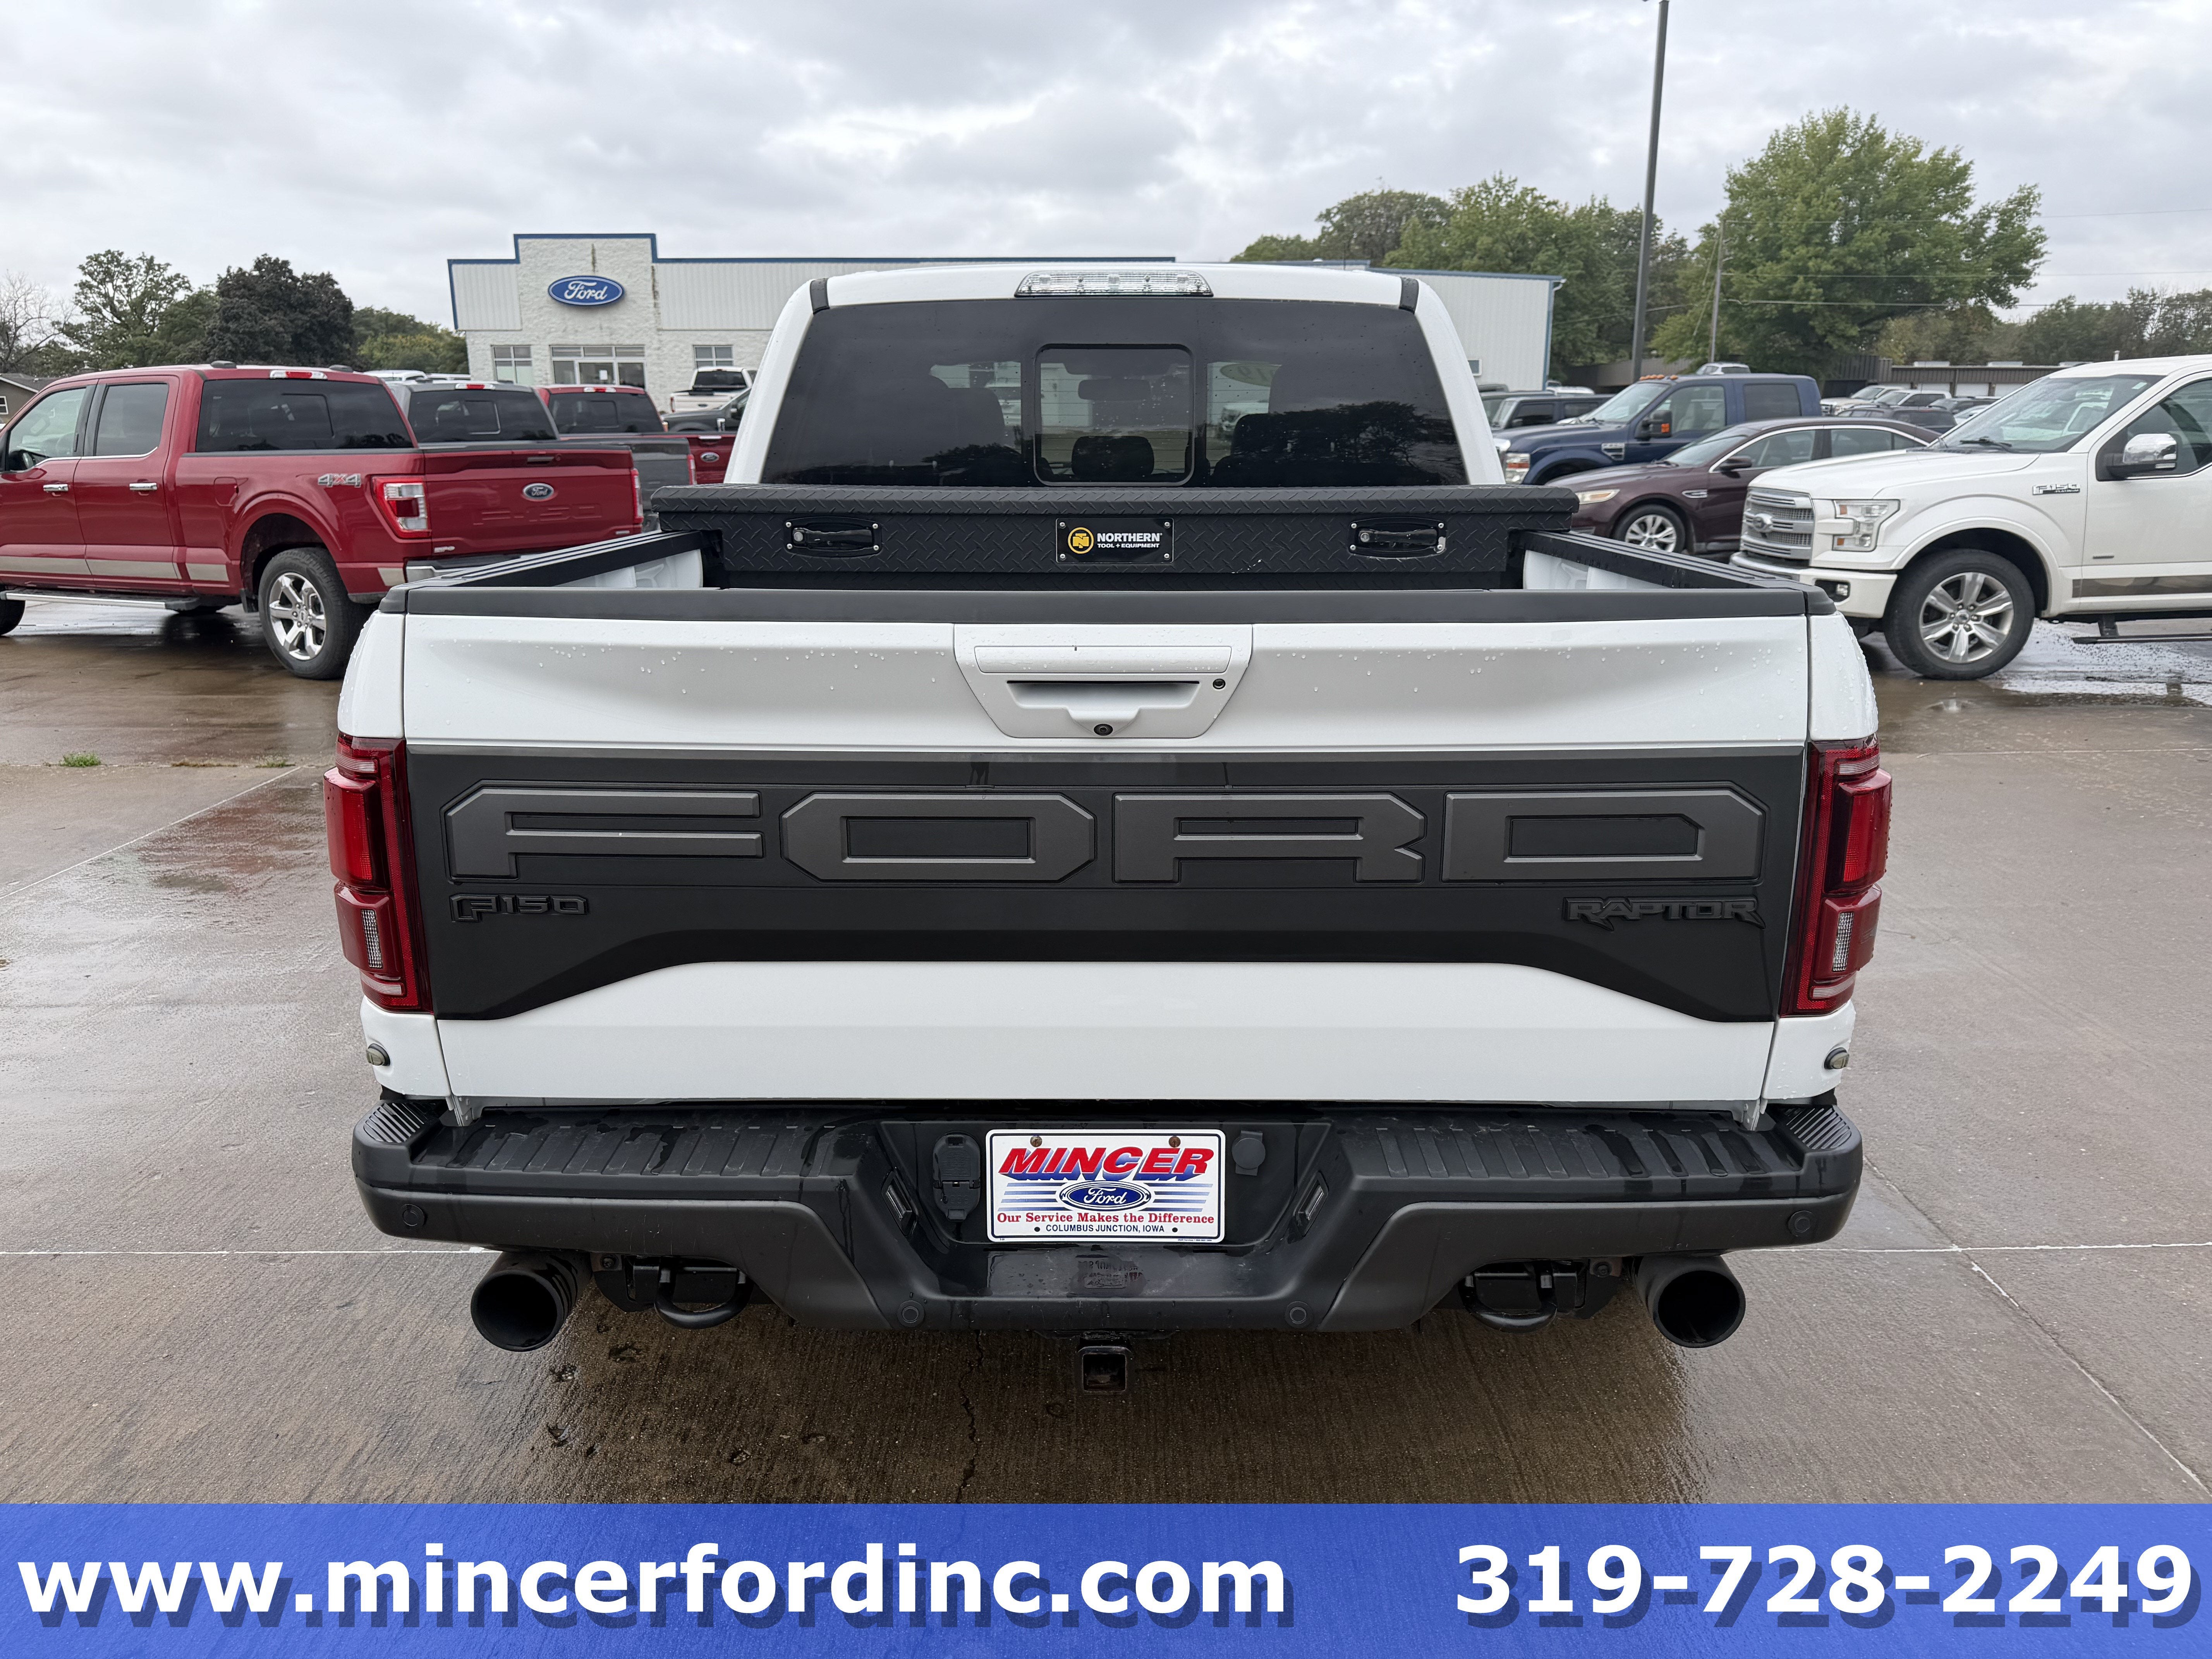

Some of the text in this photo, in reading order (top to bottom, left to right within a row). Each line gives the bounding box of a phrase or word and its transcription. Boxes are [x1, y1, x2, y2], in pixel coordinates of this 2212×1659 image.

[564, 281, 608, 300] Ford
[531, 486, 548, 497] Ford
[1097, 532, 1160, 542] NORTHERN
[445, 788, 1763, 881] FORD
[1563, 896, 1765, 931] RAPTOR
[998, 1147, 1214, 1180] MINCER
[1083, 1186, 1127, 1205] Ford
[997, 1212, 1214, 1223] Our Service Makes the Difference
[1095, 1224, 1141, 1233] JUNCTION,
